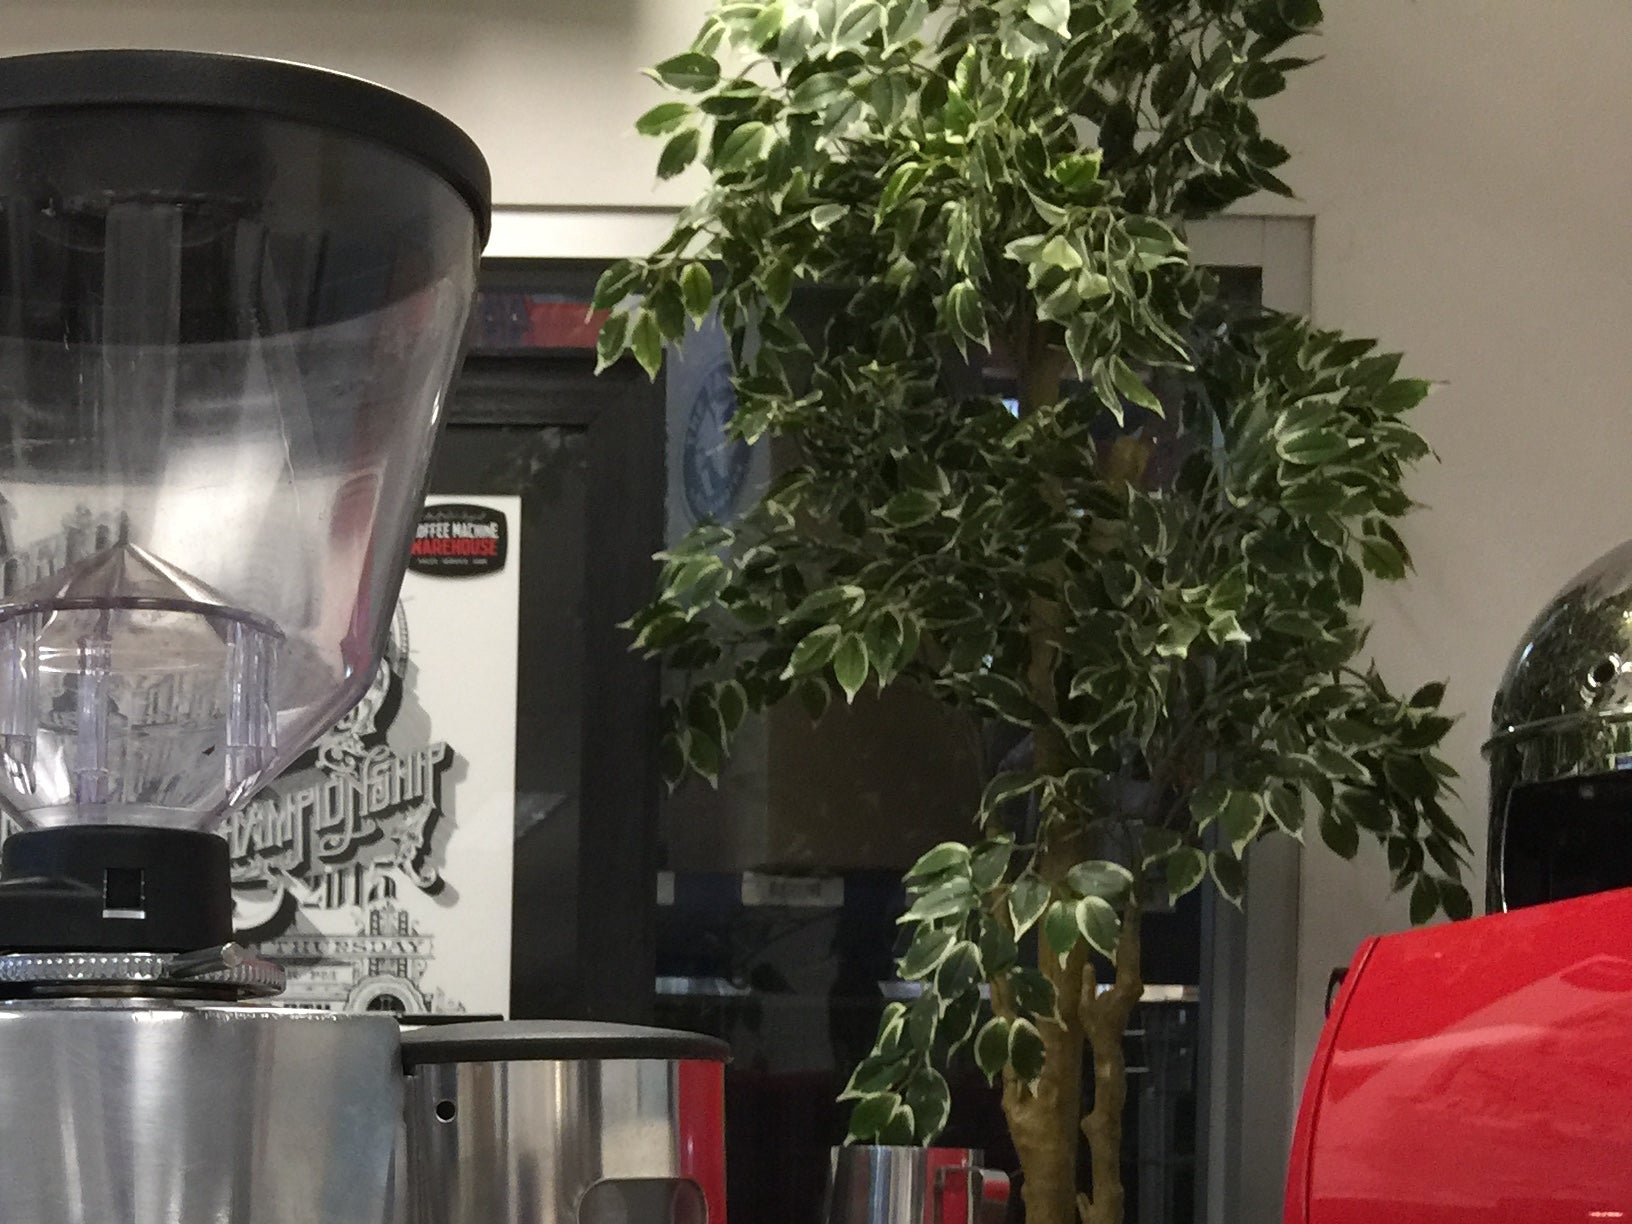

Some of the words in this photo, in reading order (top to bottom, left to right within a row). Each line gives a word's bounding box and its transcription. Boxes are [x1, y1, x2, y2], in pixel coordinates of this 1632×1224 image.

[415, 522, 450, 538] OFFEE
[218, 742, 449, 863] HAMPIONSHIP
[275, 940, 419, 954] THURSDAY
